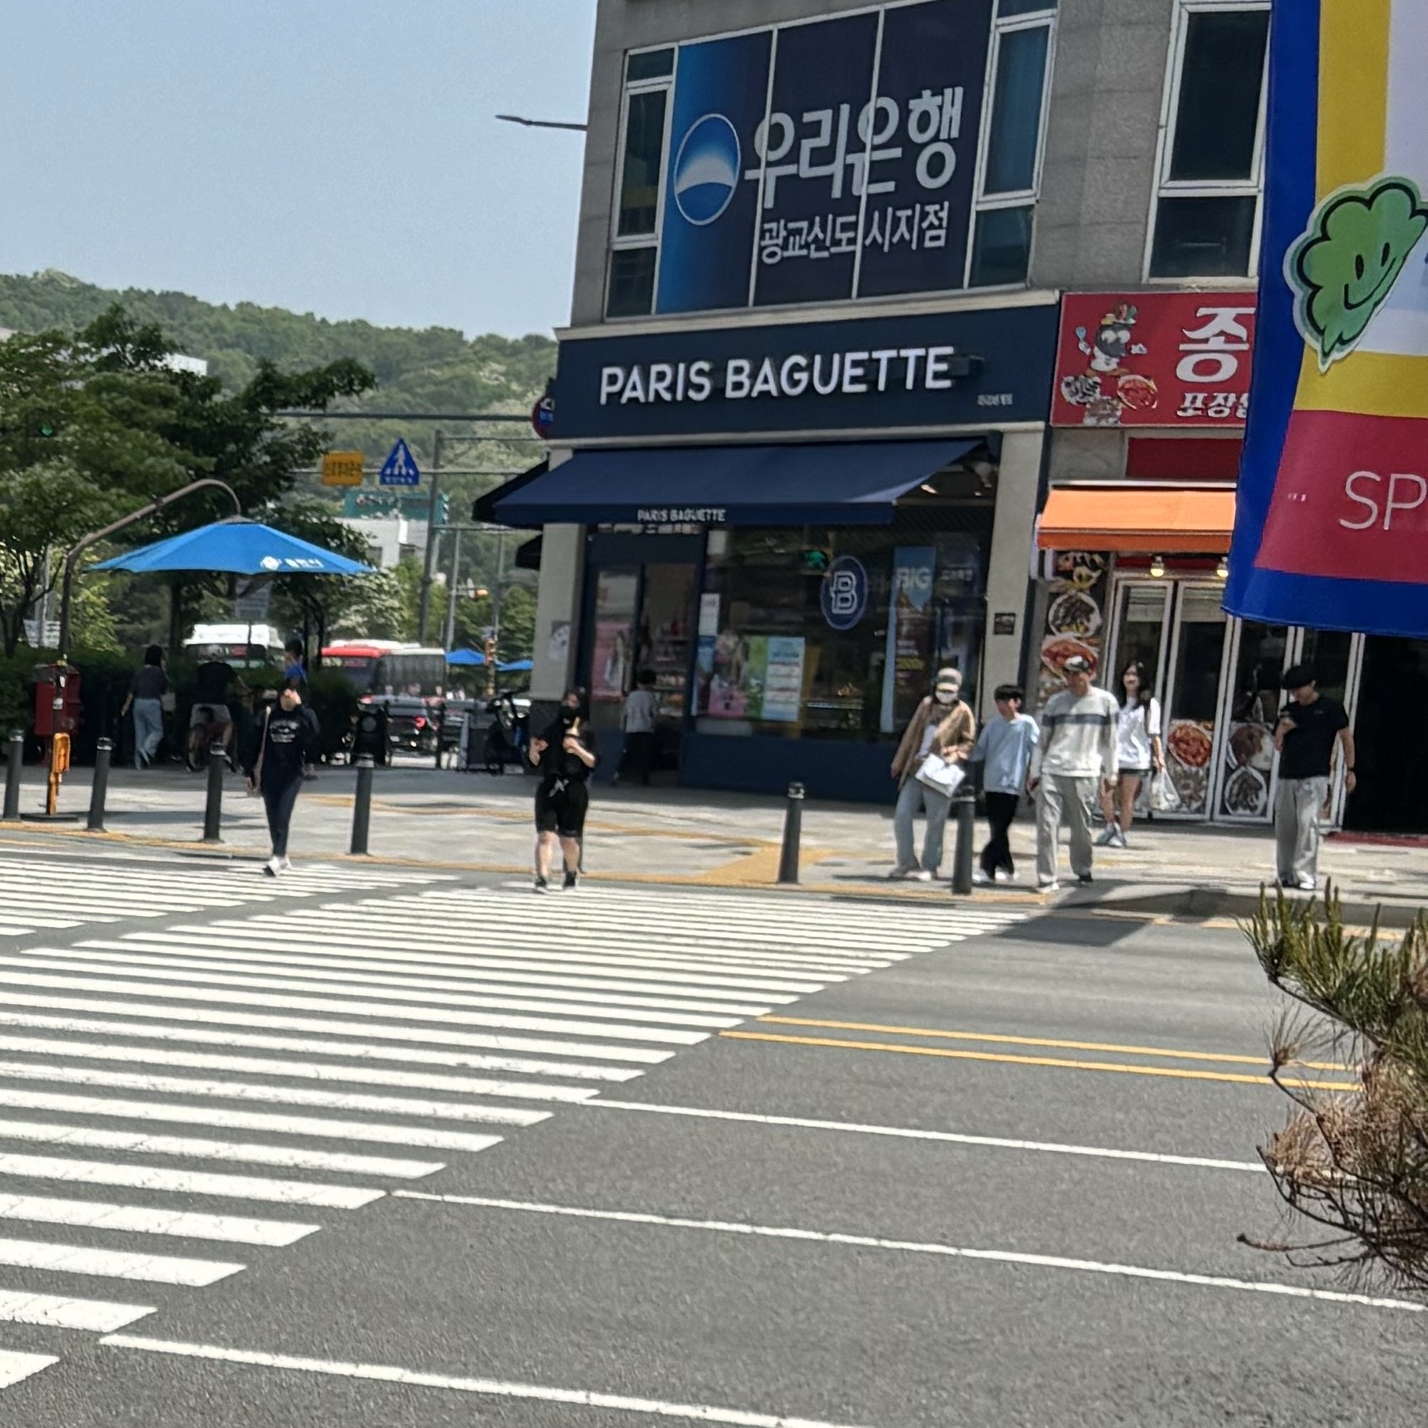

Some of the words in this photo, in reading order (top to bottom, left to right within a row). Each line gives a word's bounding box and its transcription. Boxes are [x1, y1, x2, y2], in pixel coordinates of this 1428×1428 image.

[744, 86, 964, 209] 우리은행
[760, 201, 950, 265] 광교신도시지점
[599, 360, 712, 404] PARIS
[724, 346, 954, 399] BAGUETTE
[637, 508, 668, 522] PARIS
[669, 508, 726, 522] BAGUETTE
[1339, 470, 1428, 531] SP
